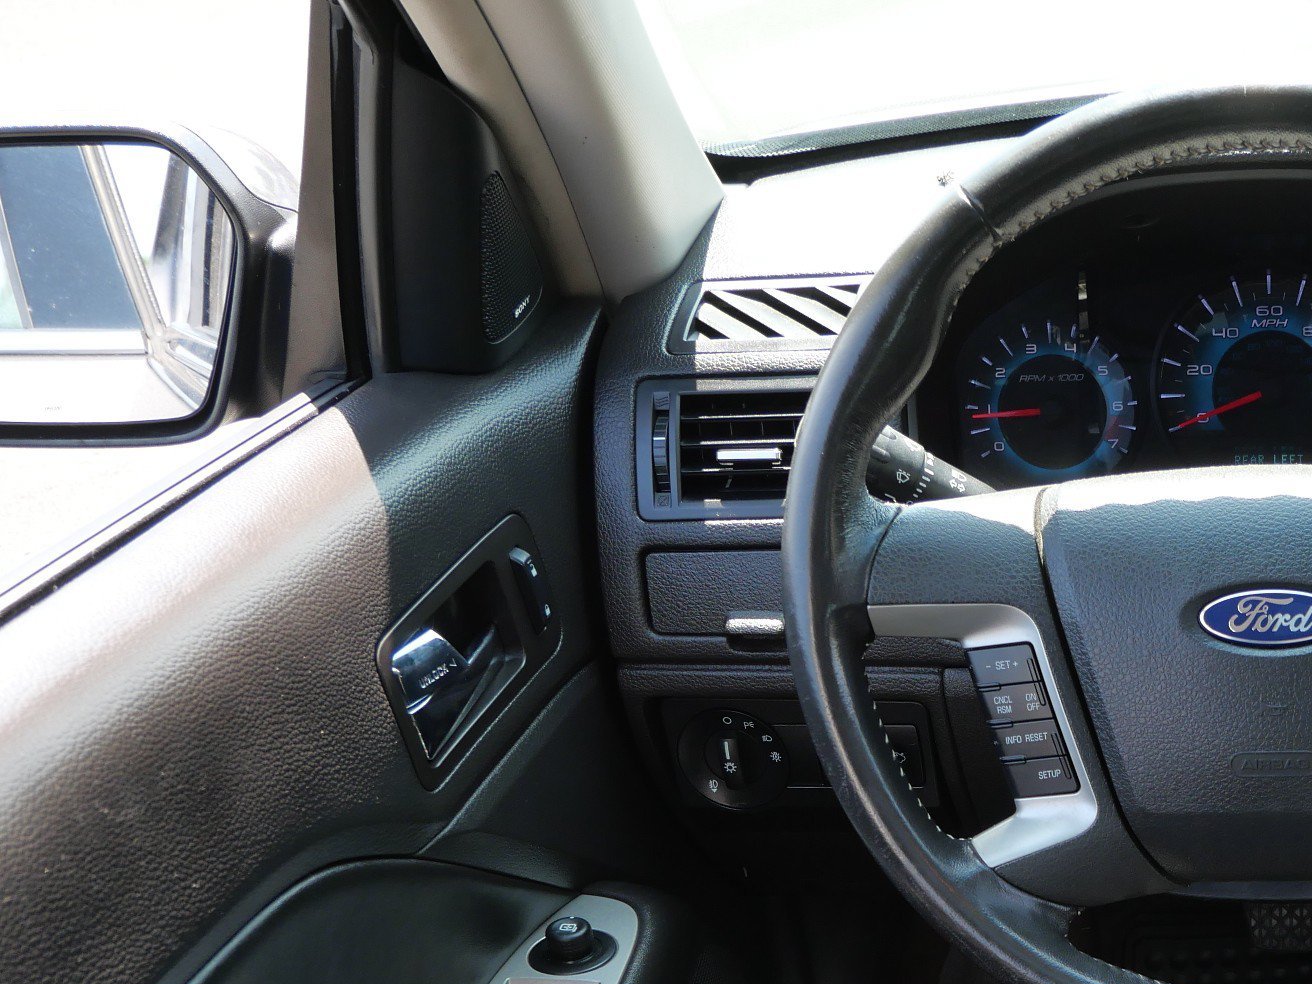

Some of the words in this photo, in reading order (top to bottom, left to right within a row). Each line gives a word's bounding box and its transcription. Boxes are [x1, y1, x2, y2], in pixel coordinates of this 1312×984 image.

[1256, 305, 1283, 316] 60
[1251, 318, 1289, 328] MPH
[1212, 327, 1239, 338] 40
[1026, 344, 1037, 354] 3
[1064, 343, 1077, 353] 4
[995, 367, 1006, 378] 2
[1097, 366, 1109, 376] 5
[1186, 364, 1213, 376] 20
[1019, 374, 1046, 382] RPM
[1058, 374, 1084, 382] 1000
[1112, 401, 1124, 411] 6
[994, 442, 1005, 451] 0
[1108, 438, 1119, 449] 7
[1234, 454, 1264, 465] REAR
[1273, 454, 1304, 465] LEFT
[995, 660, 1011, 671] SET
[994, 696, 1013, 705] CNCL
[1025, 693, 1037, 702] ON
[997, 705, 1013, 714] RSM
[1027, 703, 1040, 712] OFF
[1005, 734, 1023, 745] INFO
[1025, 732, 1048, 742] RESET
[1038, 769, 1062, 780] SETUP
